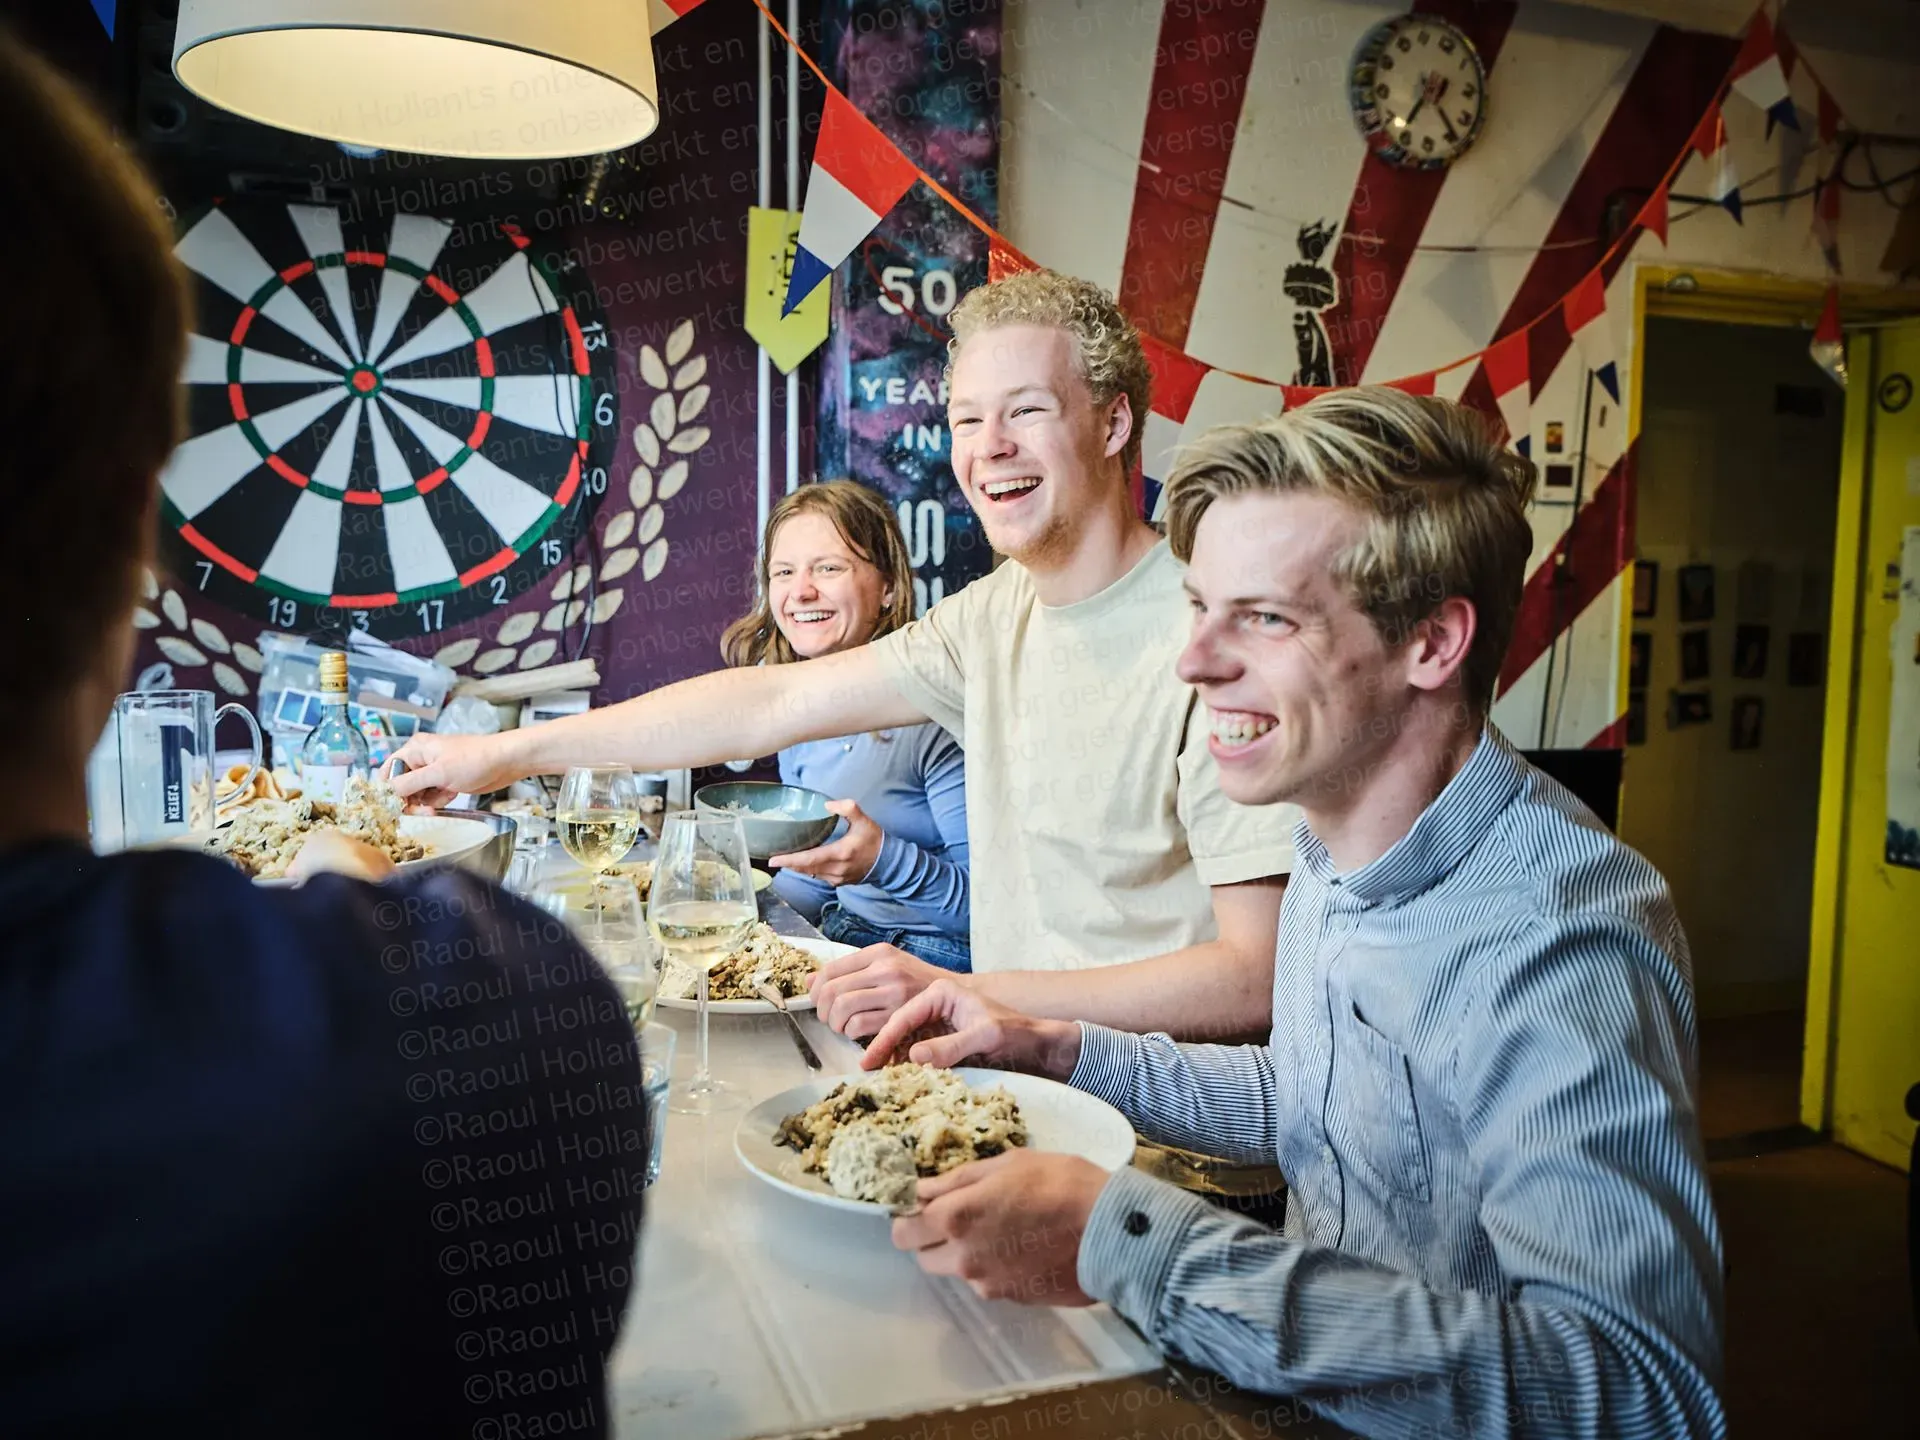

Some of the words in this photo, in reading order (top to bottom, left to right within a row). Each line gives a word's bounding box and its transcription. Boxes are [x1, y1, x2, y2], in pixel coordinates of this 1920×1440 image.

[878, 265, 957, 316] 50
[582, 320, 608, 351] 13
[594, 392, 614, 428] 6
[903, 423, 942, 450] IN
[539, 540, 563, 566] 15
[195, 561, 214, 590] 7
[490, 576, 509, 604] 2
[267, 599, 297, 628] 19
[351, 610, 370, 634] 3
[416, 599, 445, 633] 17
